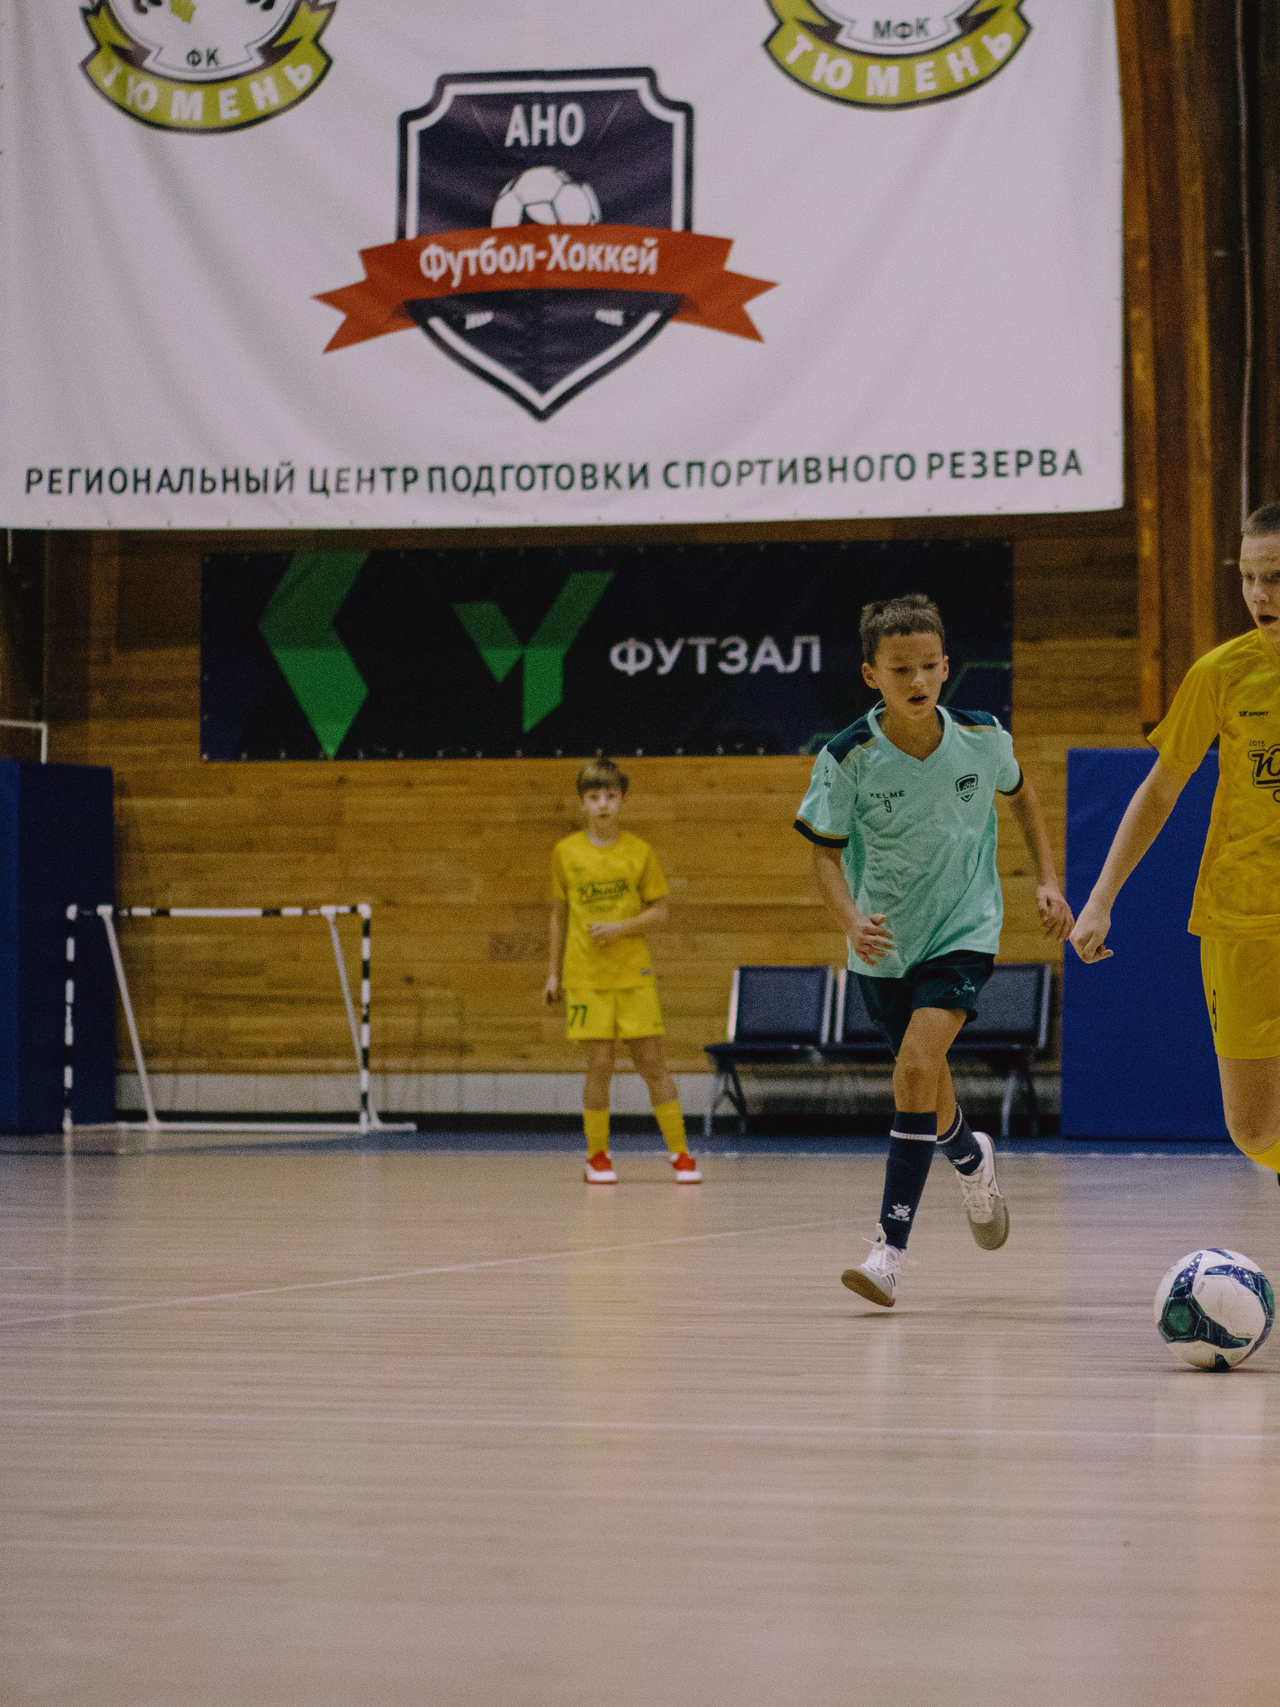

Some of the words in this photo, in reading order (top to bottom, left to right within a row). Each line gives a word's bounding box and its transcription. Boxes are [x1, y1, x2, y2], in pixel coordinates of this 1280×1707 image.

[873, 17, 932, 40] МФК
[185, 46, 220, 68] ФК
[784, 31, 1013, 98] ТЮМЕНЬ
[102, 61, 314, 122] ТЮМЕНЬ
[504, 102, 585, 148] АНО
[419, 234, 659, 288] Футбол-Хоккей
[24, 461, 296, 496] РЕГИОНАЛЬНЫЙ
[309, 465, 419, 497] ЦЕНТР
[428, 462, 651, 496] ПОДГОТОВКИ
[662, 452, 917, 490] СПОРТИВНОГО
[926, 448, 1083, 480] РЕЗЕРВА
[609, 635, 822, 676] ФУТЗАЛ
[569, 1004, 588, 1028] 77
